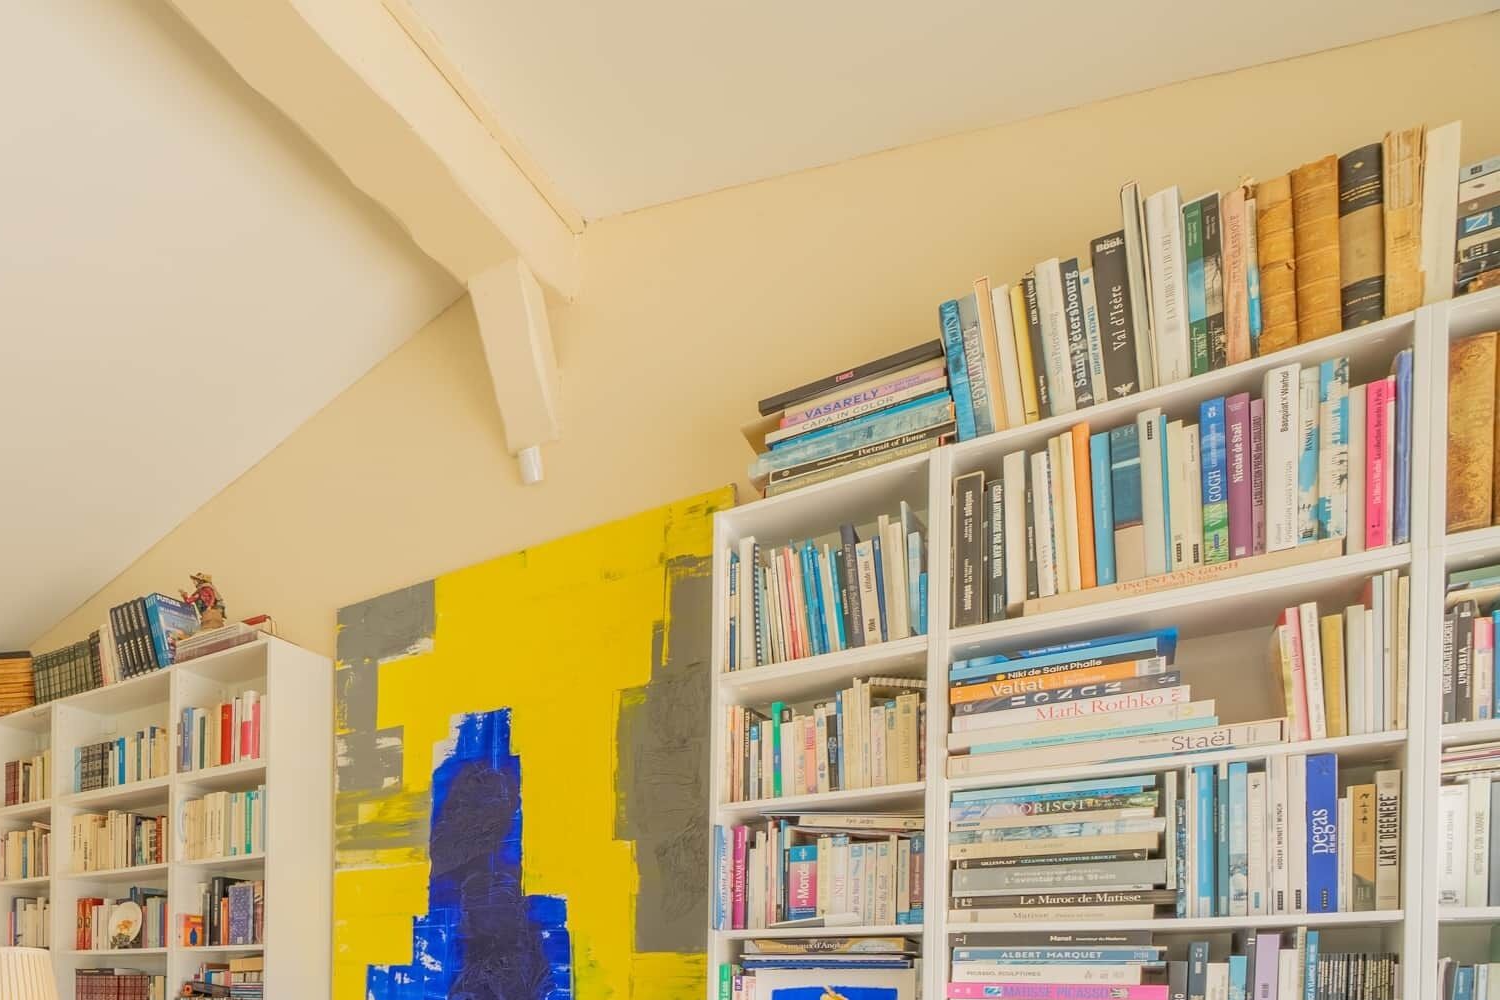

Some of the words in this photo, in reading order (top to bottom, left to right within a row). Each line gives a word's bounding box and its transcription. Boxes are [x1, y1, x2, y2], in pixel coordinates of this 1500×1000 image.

[1109, 284, 1126, 327] d'Isère
[1065, 270, 1088, 388] Saint-Pétersbourg
[1113, 329, 1127, 351] Val
[963, 326, 987, 409] L'ERMITAGE
[1279, 371, 1290, 396] Warhol
[801, 417, 834, 431] CAPA
[835, 411, 849, 420] IN
[851, 396, 894, 415] COLOR
[804, 388, 879, 418] VASARELY
[1280, 402, 1291, 432] Basquiat
[1230, 422, 1242, 443] Staël
[858, 441, 890, 456] Portrait
[891, 438, 900, 449] of
[902, 433, 927, 445] Rome
[1232, 443, 1242, 452] de
[1232, 453, 1244, 483] Nicolas
[1208, 470, 1221, 502] GOGH
[1116, 573, 1170, 591] VINCENT
[1173, 569, 1197, 581] VAN
[1199, 561, 1238, 575] GOGH
[1008, 671, 1026, 680] Niki
[1027, 668, 1041, 676] de
[1043, 664, 1068, 674] Saint
[1069, 659, 1102, 672] Phalle
[1443, 652, 1453, 675] INSOLITE
[1458, 647, 1468, 685] UMBRIA
[991, 680, 1045, 697] Valtat
[1036, 704, 1083, 721] Mark
[1091, 692, 1164, 713] Rothko
[1172, 728, 1234, 750] Staël
[1311, 808, 1335, 854] Degas
[1380, 845, 1397, 867] L'ART
[798, 863, 810, 899] Monde
[1004, 876, 1061, 884] L'aventure
[1063, 874, 1080, 882] des
[1085, 872, 1116, 881] Stein
[735, 893, 743, 903] LA
[1020, 896, 1035, 905] Le
[1038, 895, 1073, 904] Maroc
[1077, 894, 1092, 903] de
[1096, 892, 1141, 903] Matisse
[1001, 951, 1041, 959] ALBERT
[1047, 951, 1102, 959] MARQUET
[720, 980, 729, 997] Laos
[1003, 987, 1054, 997] MATISSE
[1056, 987, 1109, 998] PICASSO
